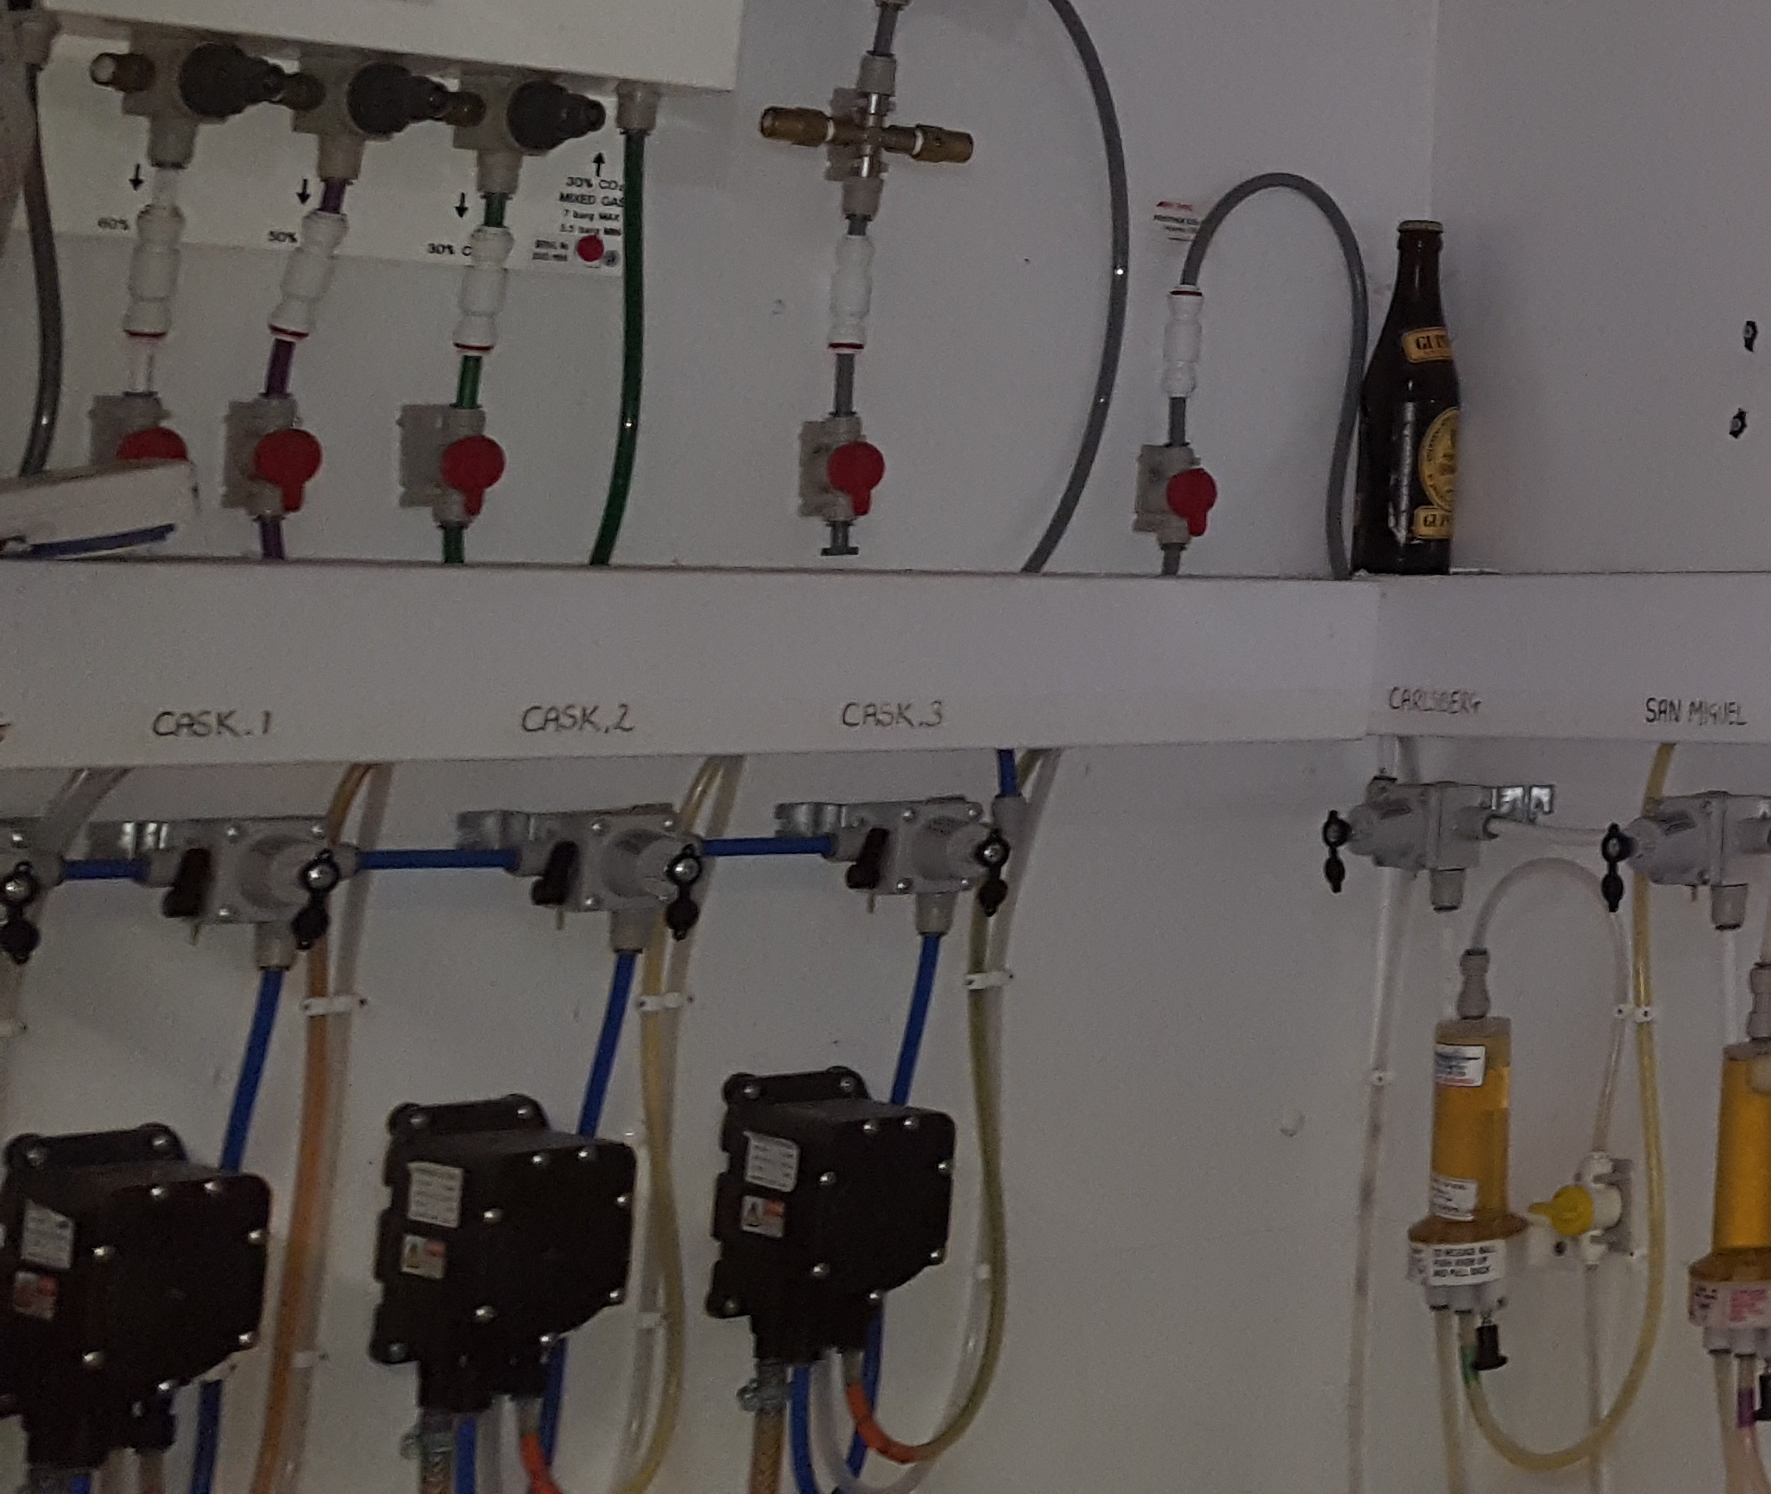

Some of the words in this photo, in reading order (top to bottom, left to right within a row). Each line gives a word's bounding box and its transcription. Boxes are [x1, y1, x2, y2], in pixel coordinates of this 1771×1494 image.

[565, 176, 594, 188] 30%
[559, 192, 596, 205] MIXED
[1645, 696, 1682, 724] SAN
[1687, 700, 1749, 726] MIGUEL
